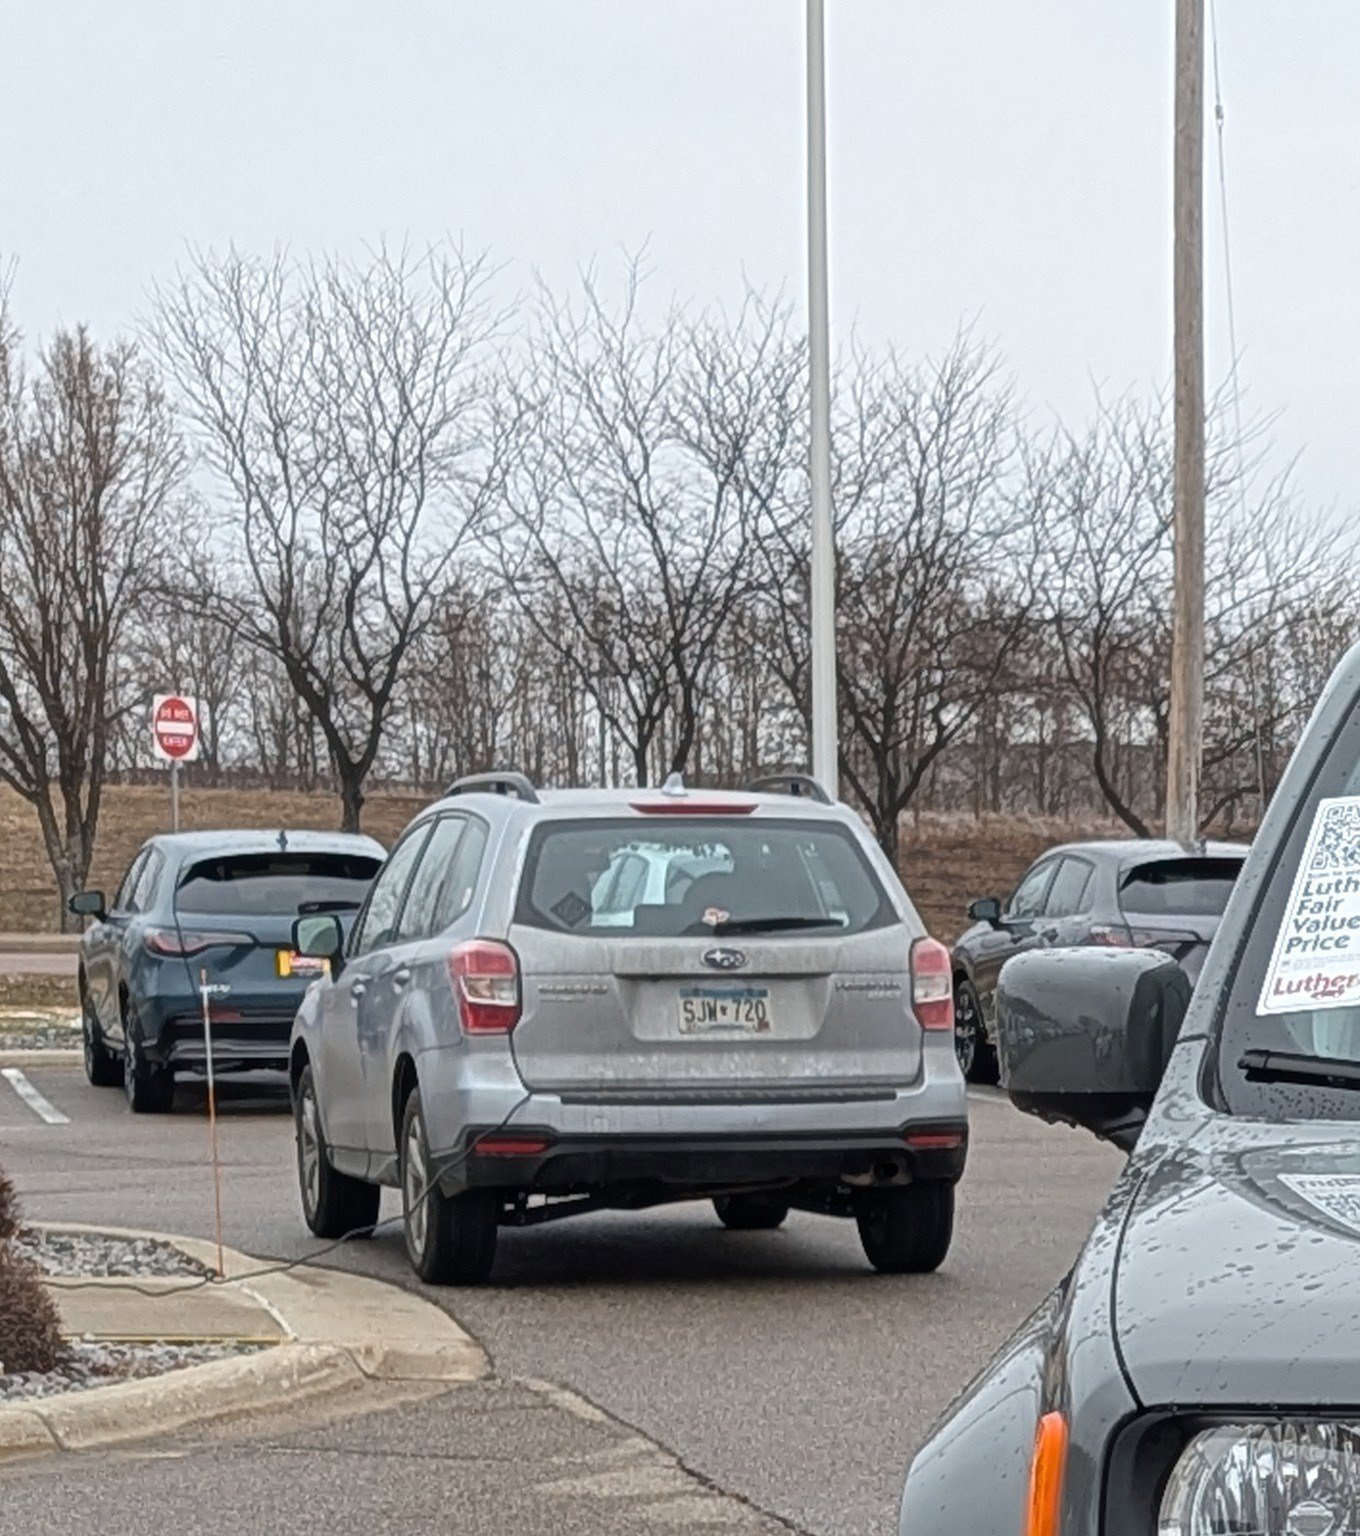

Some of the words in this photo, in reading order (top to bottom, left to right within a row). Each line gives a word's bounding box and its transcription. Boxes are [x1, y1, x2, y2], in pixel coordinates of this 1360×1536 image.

[1296, 896, 1345, 916] Fair
[1284, 934, 1351, 954] Price
[1273, 973, 1360, 997] Luther
[683, 999, 717, 1022] SJW
[732, 999, 767, 1022] 720
